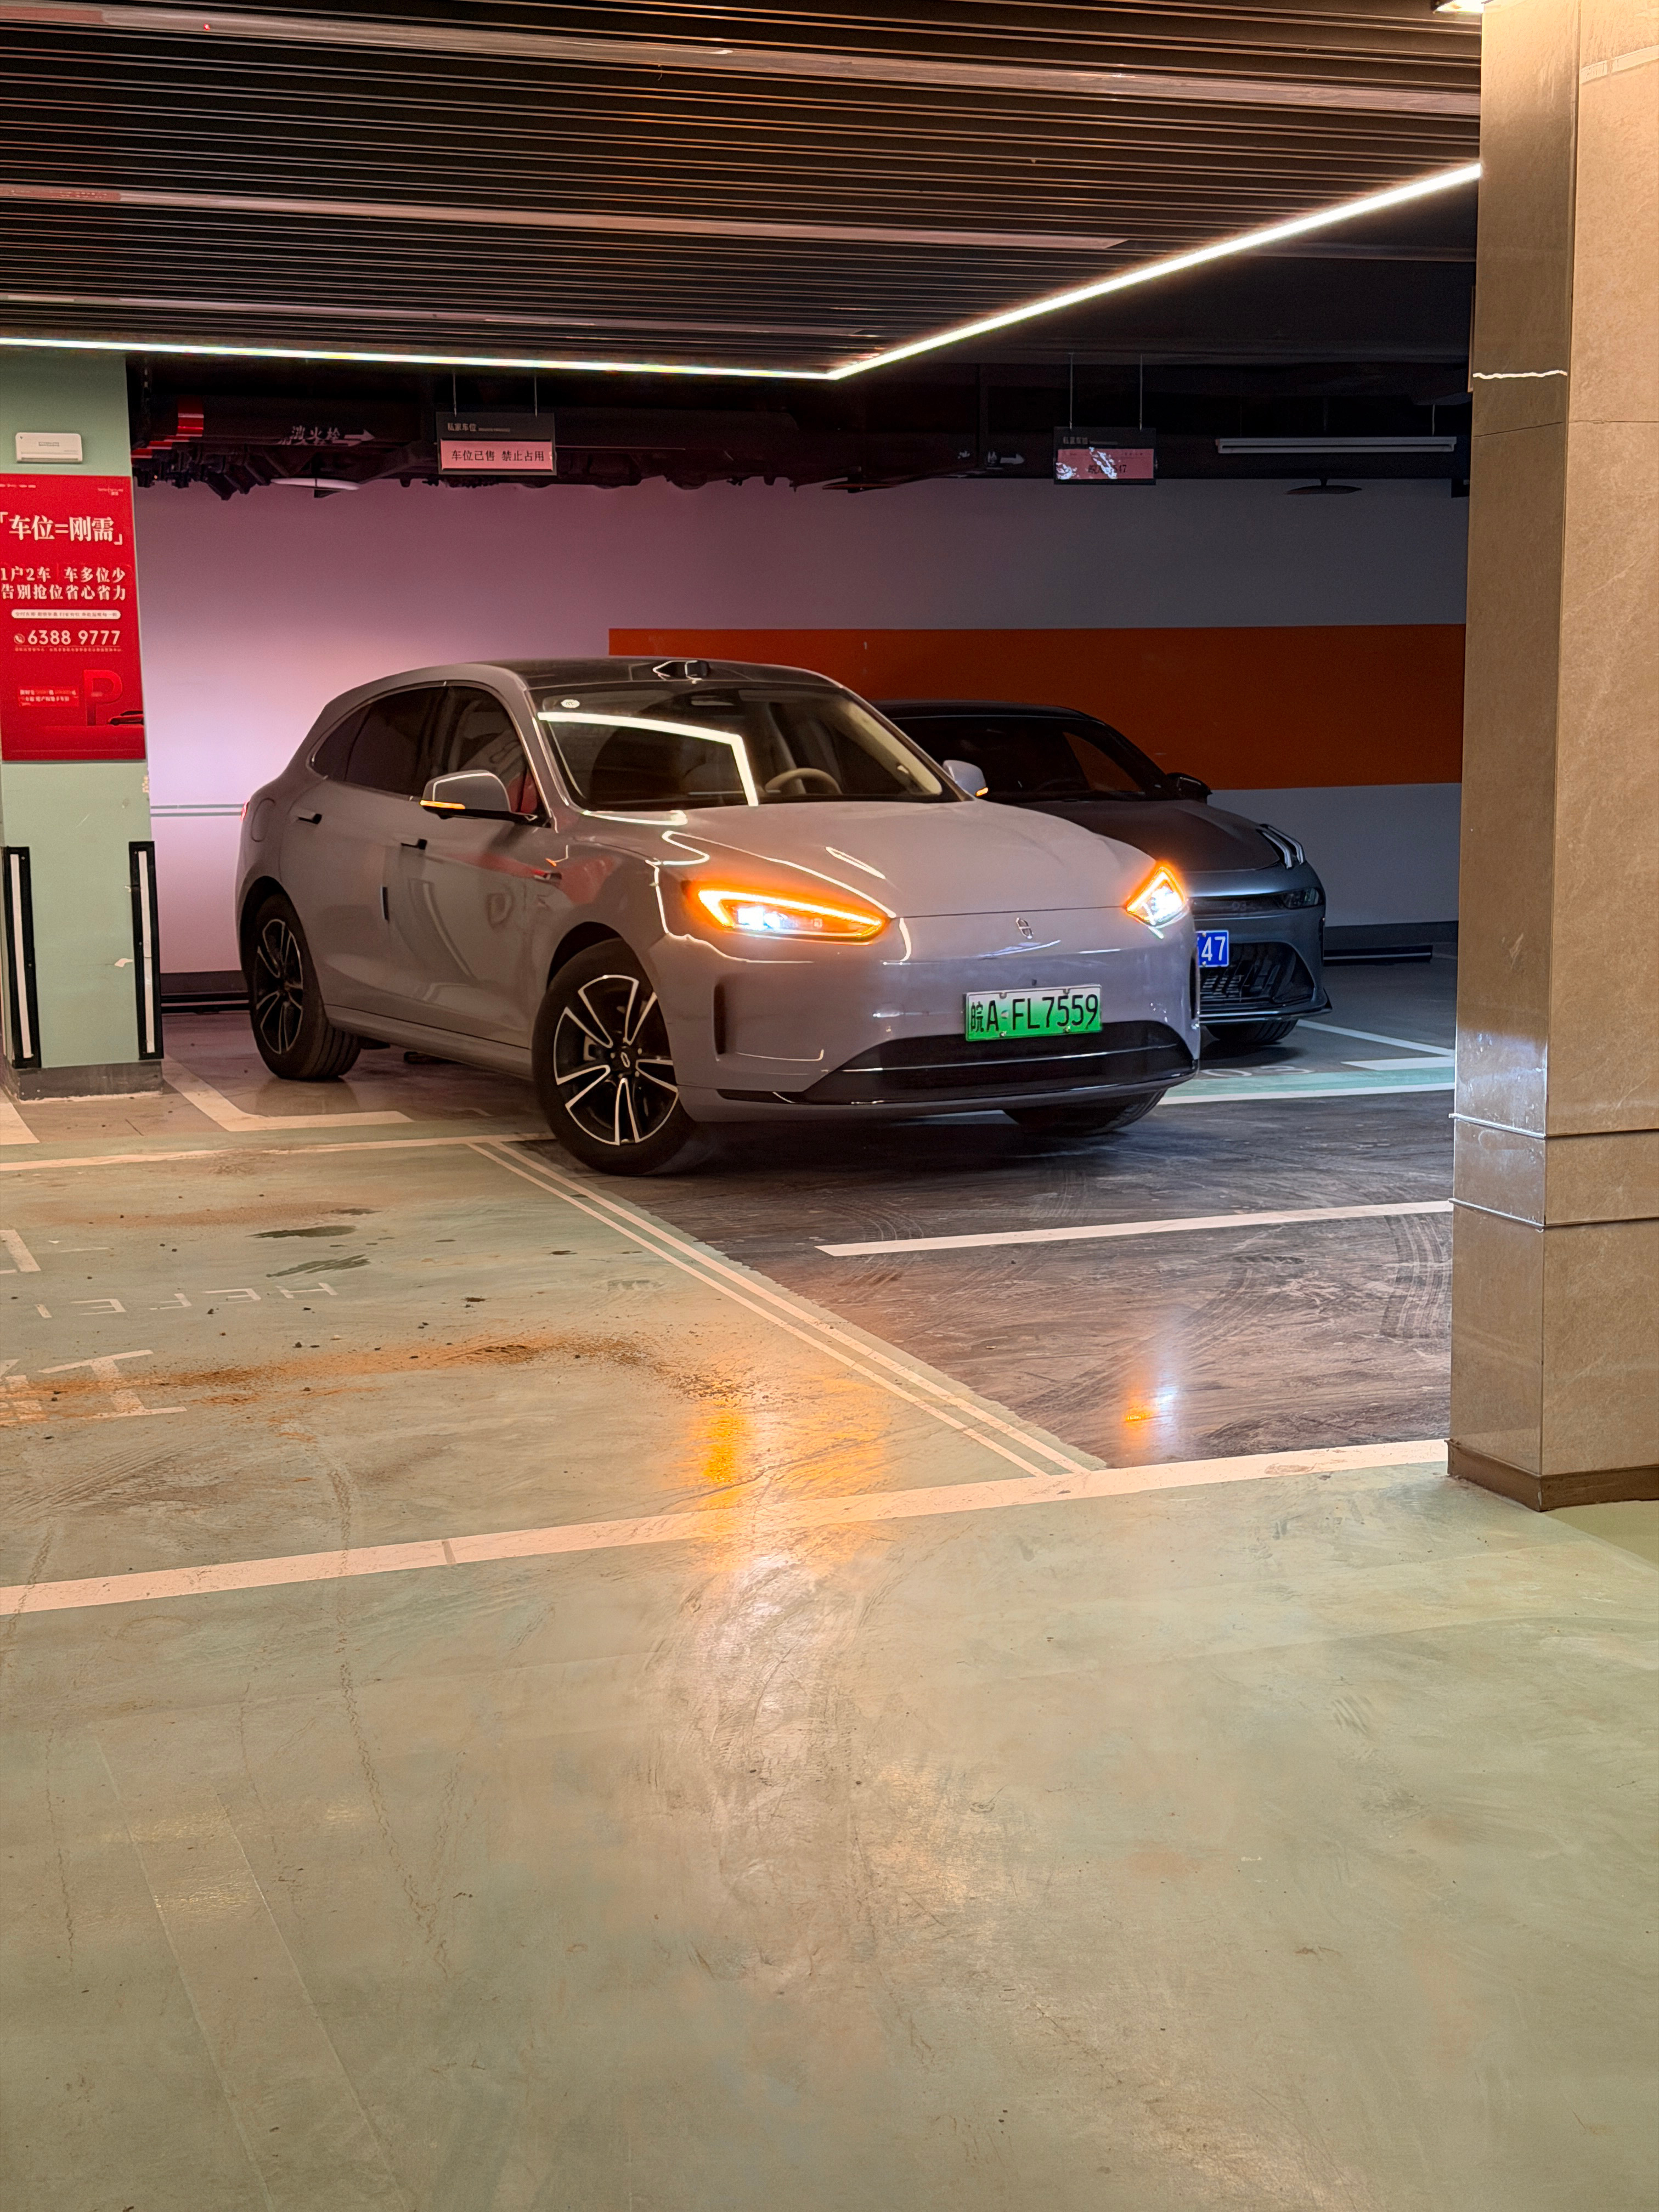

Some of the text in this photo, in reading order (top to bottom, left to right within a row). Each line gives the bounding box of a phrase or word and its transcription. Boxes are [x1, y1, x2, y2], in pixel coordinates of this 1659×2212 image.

[452, 450, 544, 462] 车位已售 禁止占用
[1, 566, 126, 583] 1户2车 车多位少
[1, 583, 126, 601] 告别抢位省心省力
[27, 630, 121, 645] 6388 9777
[83, 669, 123, 727] P
[1197, 936, 1226, 962] 47
